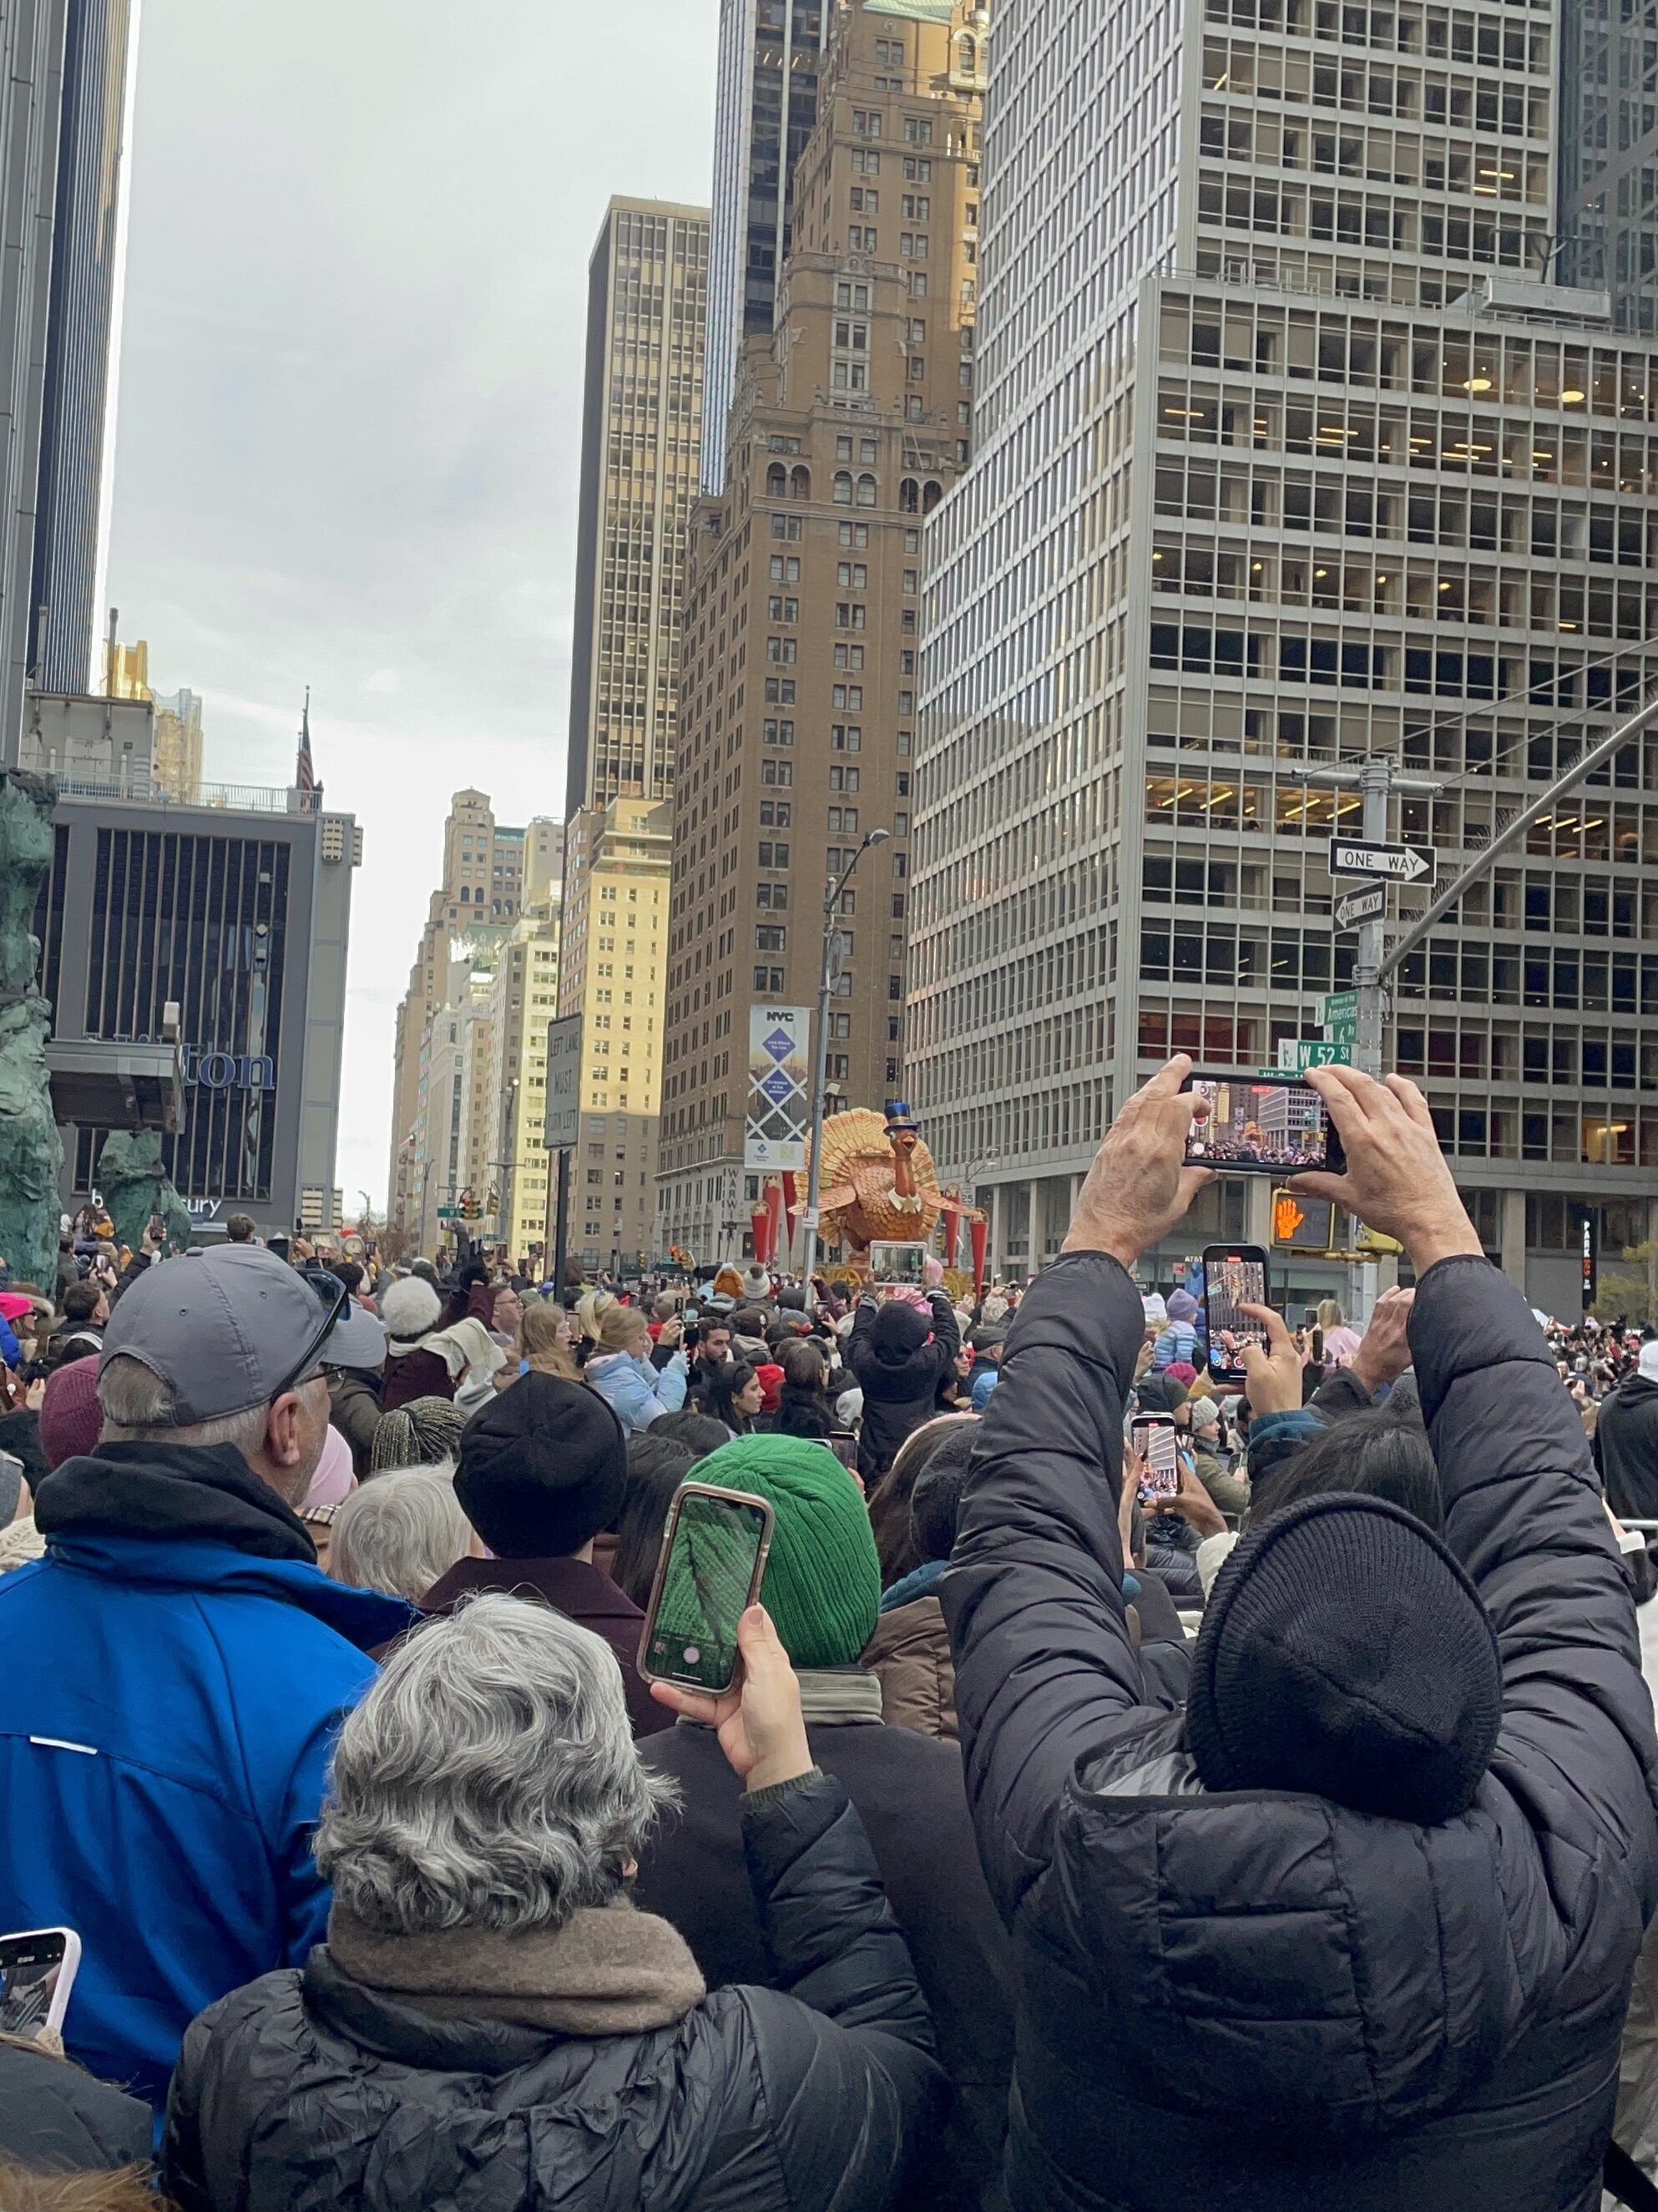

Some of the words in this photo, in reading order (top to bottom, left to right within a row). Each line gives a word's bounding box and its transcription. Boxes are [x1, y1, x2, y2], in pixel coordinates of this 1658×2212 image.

[1345, 851, 1374, 868] ONE
[1388, 856, 1419, 872] WAY
[1340, 903, 1355, 920] ONE
[1361, 894, 1379, 912] WAY
[766, 1010, 794, 1022] NYC
[1327, 1005, 1357, 1022] Americas
[550, 1036, 564, 1057] LEFT
[565, 1031, 579, 1054] LANE
[1339, 1026, 1345, 1044] 6
[1347, 1024, 1355, 1037] Av
[1299, 1045, 1312, 1067] W
[1317, 1046, 1336, 1066] 52
[1340, 1046, 1350, 1060] St
[554, 1069, 573, 1096] MUST
[563, 1109, 576, 1130] LEFT
[727, 1167, 739, 1220] WARWI
[962, 1195, 973, 1203] 25
